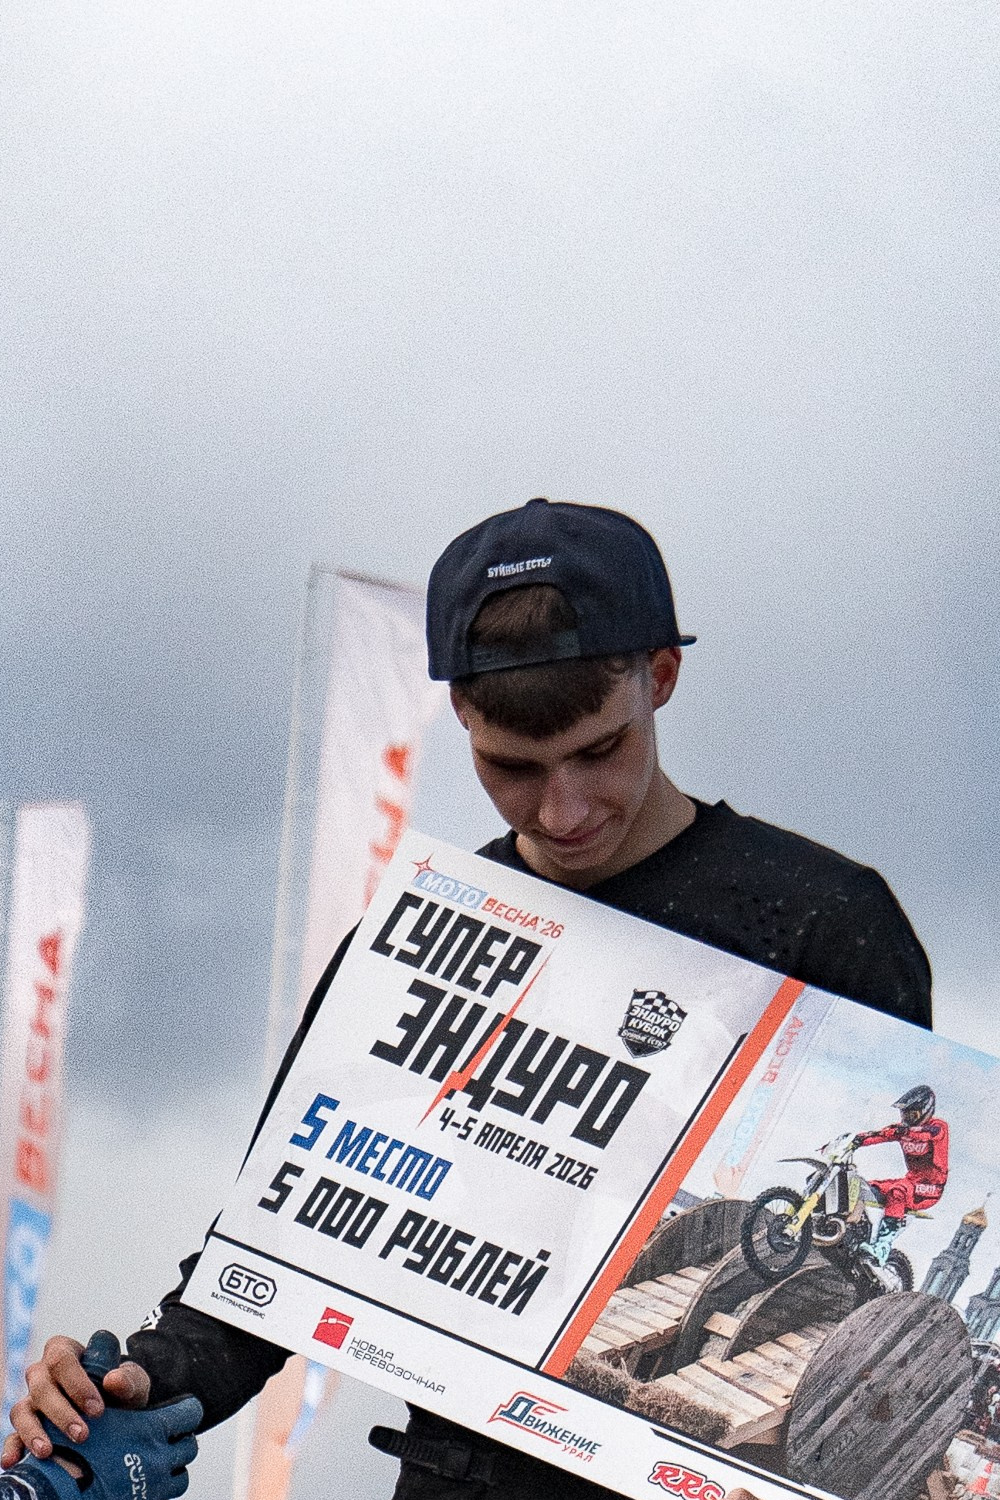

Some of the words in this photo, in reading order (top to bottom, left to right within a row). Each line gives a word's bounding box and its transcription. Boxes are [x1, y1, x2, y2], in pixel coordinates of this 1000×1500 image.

[421, 873, 482, 907] МОТО
[370, 891, 543, 997] СУПЕР
[628, 1018, 669, 1039] КУБОК
[629, 1006, 680, 1032] ЭНДУРО
[369, 979, 652, 1150] ЭНДУРО
[289, 1093, 340, 1150] 5
[326, 1121, 454, 1201] МЕСТО
[438, 1106, 477, 1143] 4-5
[475, 1123, 546, 1170] АПРЕЛЯ
[545, 1153, 599, 1191] 2026
[257, 1161, 305, 1214] 5
[294, 1176, 389, 1249] 000
[379, 1209, 552, 1317] РУБЛЕЙ
[226, 1270, 270, 1300] БТС
[350, 1336, 395, 1361] НОВАЯ
[346, 1346, 446, 1395] ПЕРЕВОЗОЧНАЯ
[561, 1444, 594, 1463] УРАЛ
